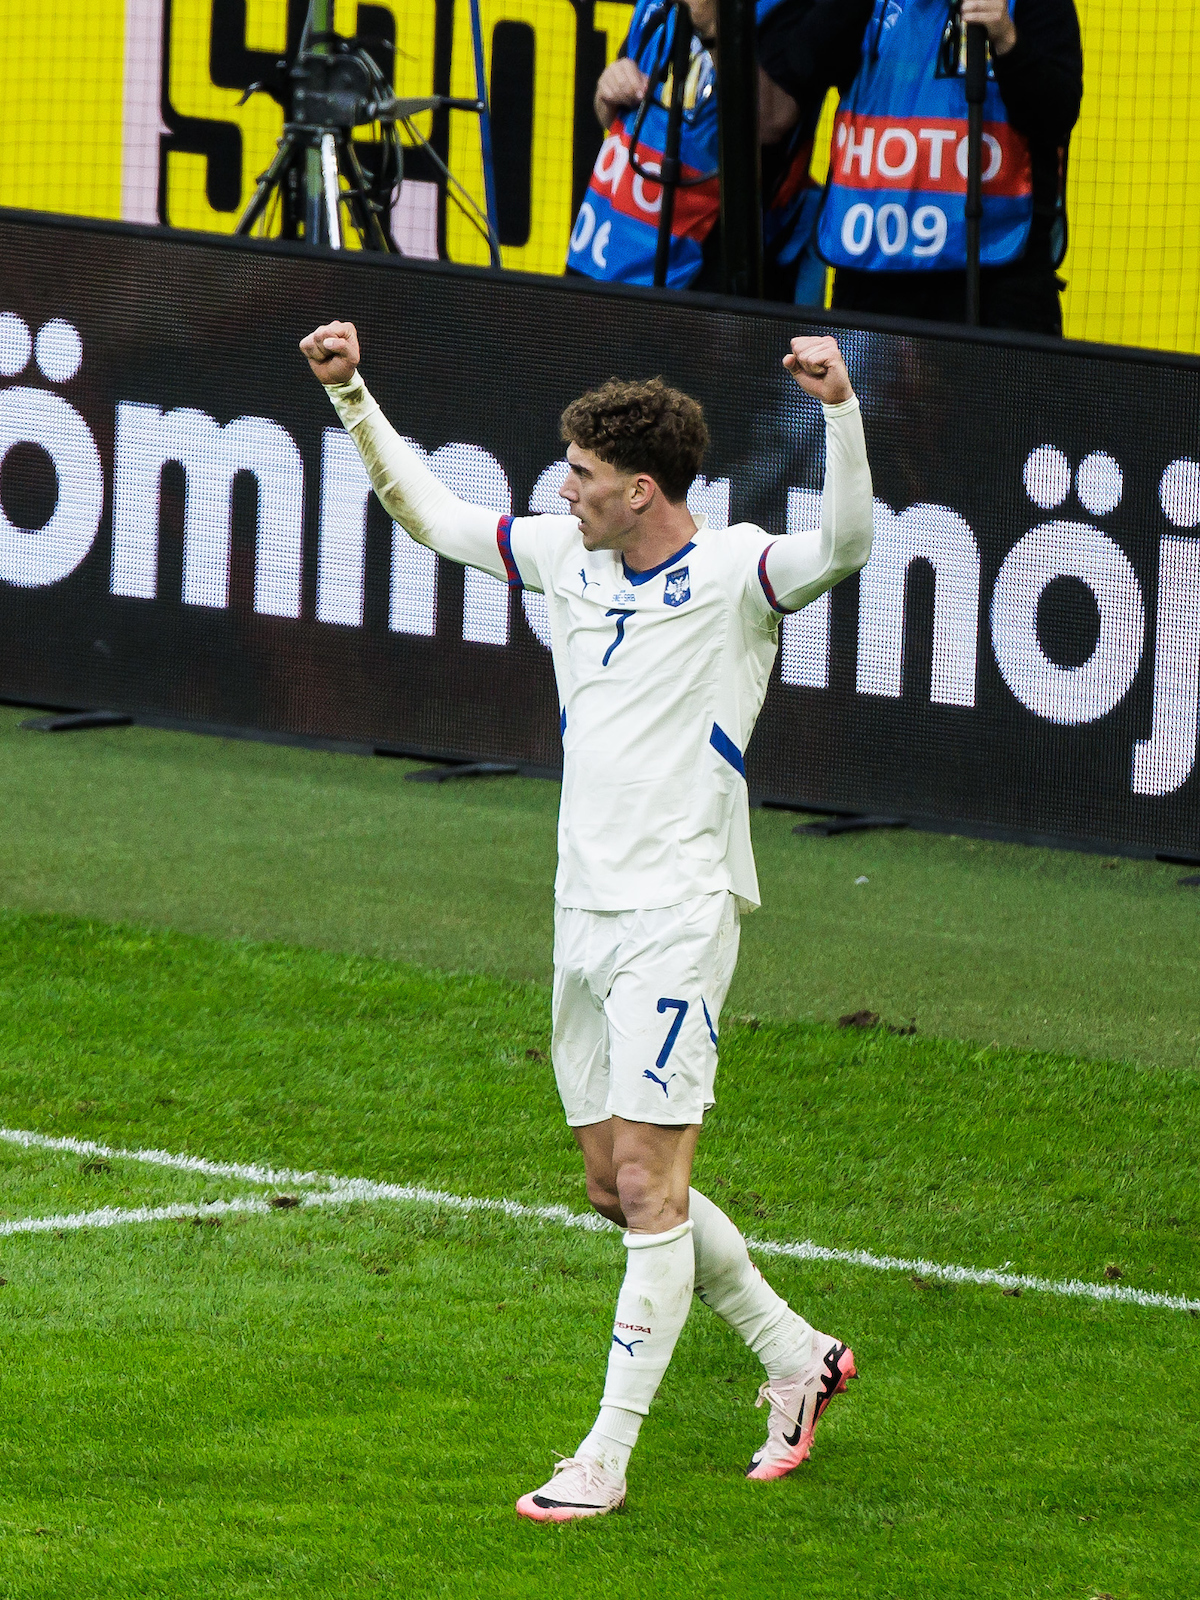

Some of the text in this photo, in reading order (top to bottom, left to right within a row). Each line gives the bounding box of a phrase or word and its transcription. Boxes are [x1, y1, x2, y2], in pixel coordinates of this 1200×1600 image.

[841, 202, 948, 257] 009
[602, 608, 637, 667] 7
[655, 997, 689, 1069] 7
